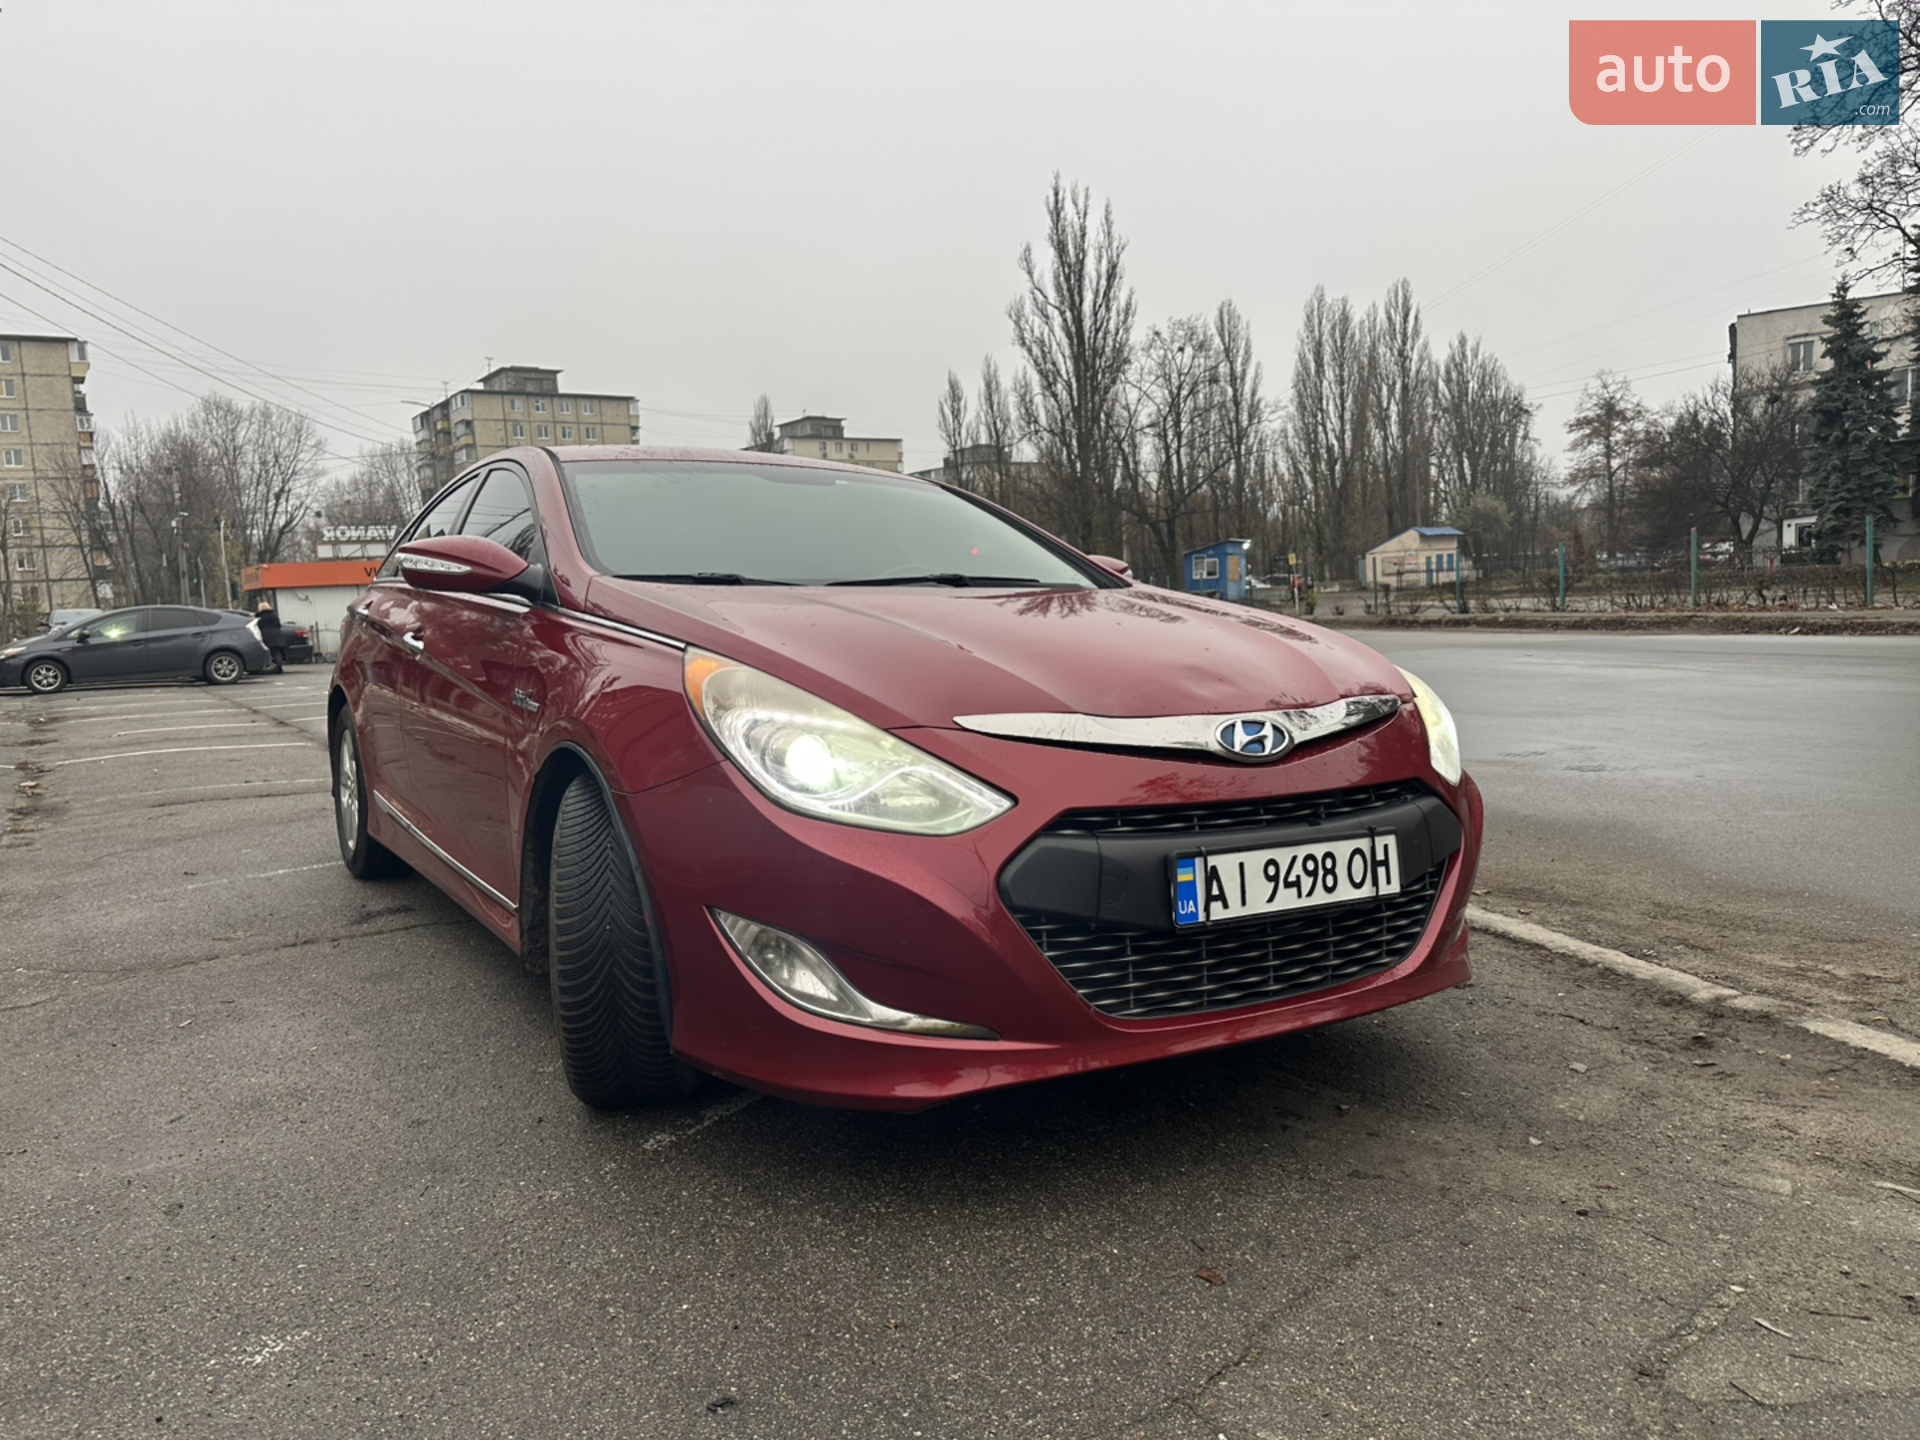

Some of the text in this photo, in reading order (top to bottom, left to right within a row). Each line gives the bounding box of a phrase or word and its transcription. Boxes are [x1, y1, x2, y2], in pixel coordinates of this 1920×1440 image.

[1203, 843, 1392, 913] AI 9498 OH
[1178, 900, 1197, 915] UA
